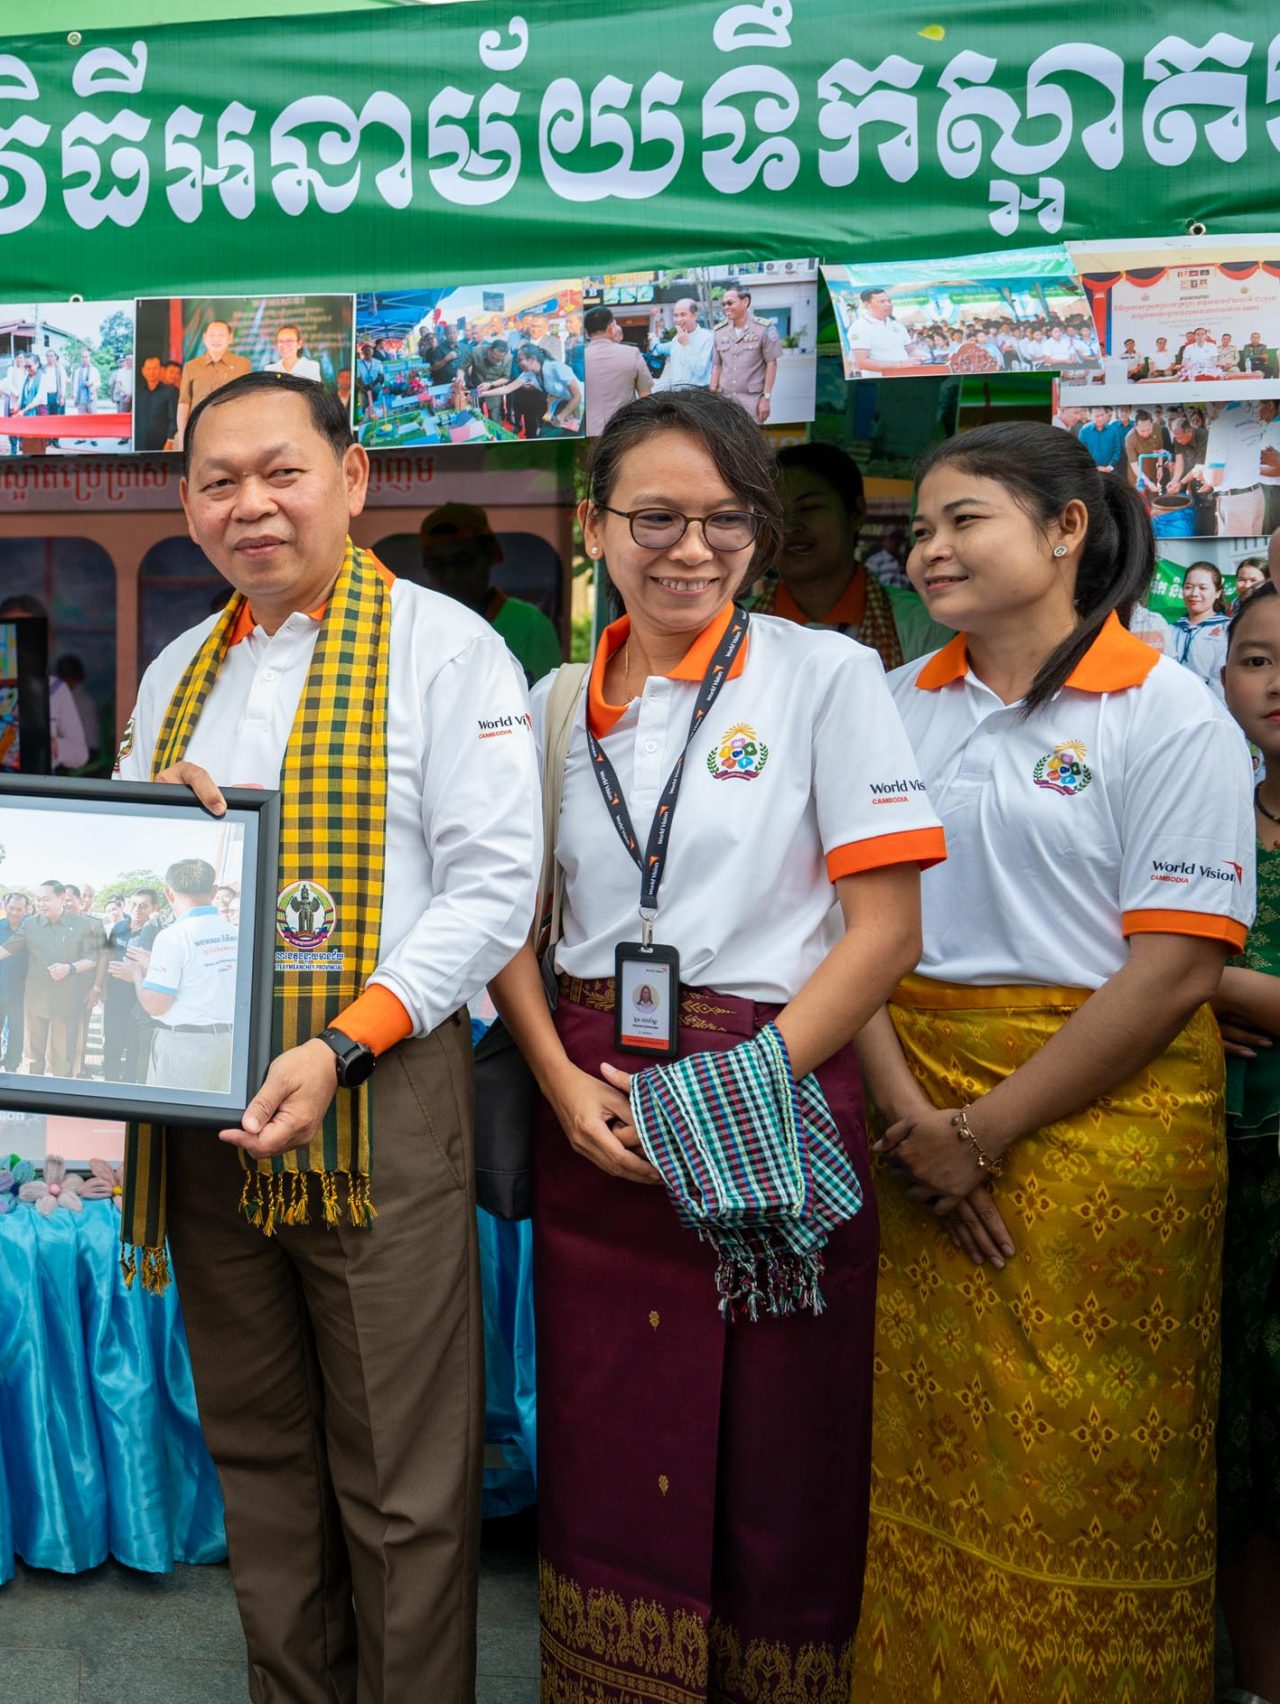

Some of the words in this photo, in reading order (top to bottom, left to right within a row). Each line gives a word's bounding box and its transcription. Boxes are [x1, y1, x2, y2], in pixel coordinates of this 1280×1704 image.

[478, 716, 512, 729] World
[479, 729, 512, 739] CAMBODIA
[870, 779, 908, 794] World
[909, 779, 926, 791] Vis
[872, 796, 908, 805] CAMBODIA
[1152, 860, 1196, 875] World
[1199, 865, 1237, 883] Vision
[1150, 874, 1189, 885] CAMBODIA
